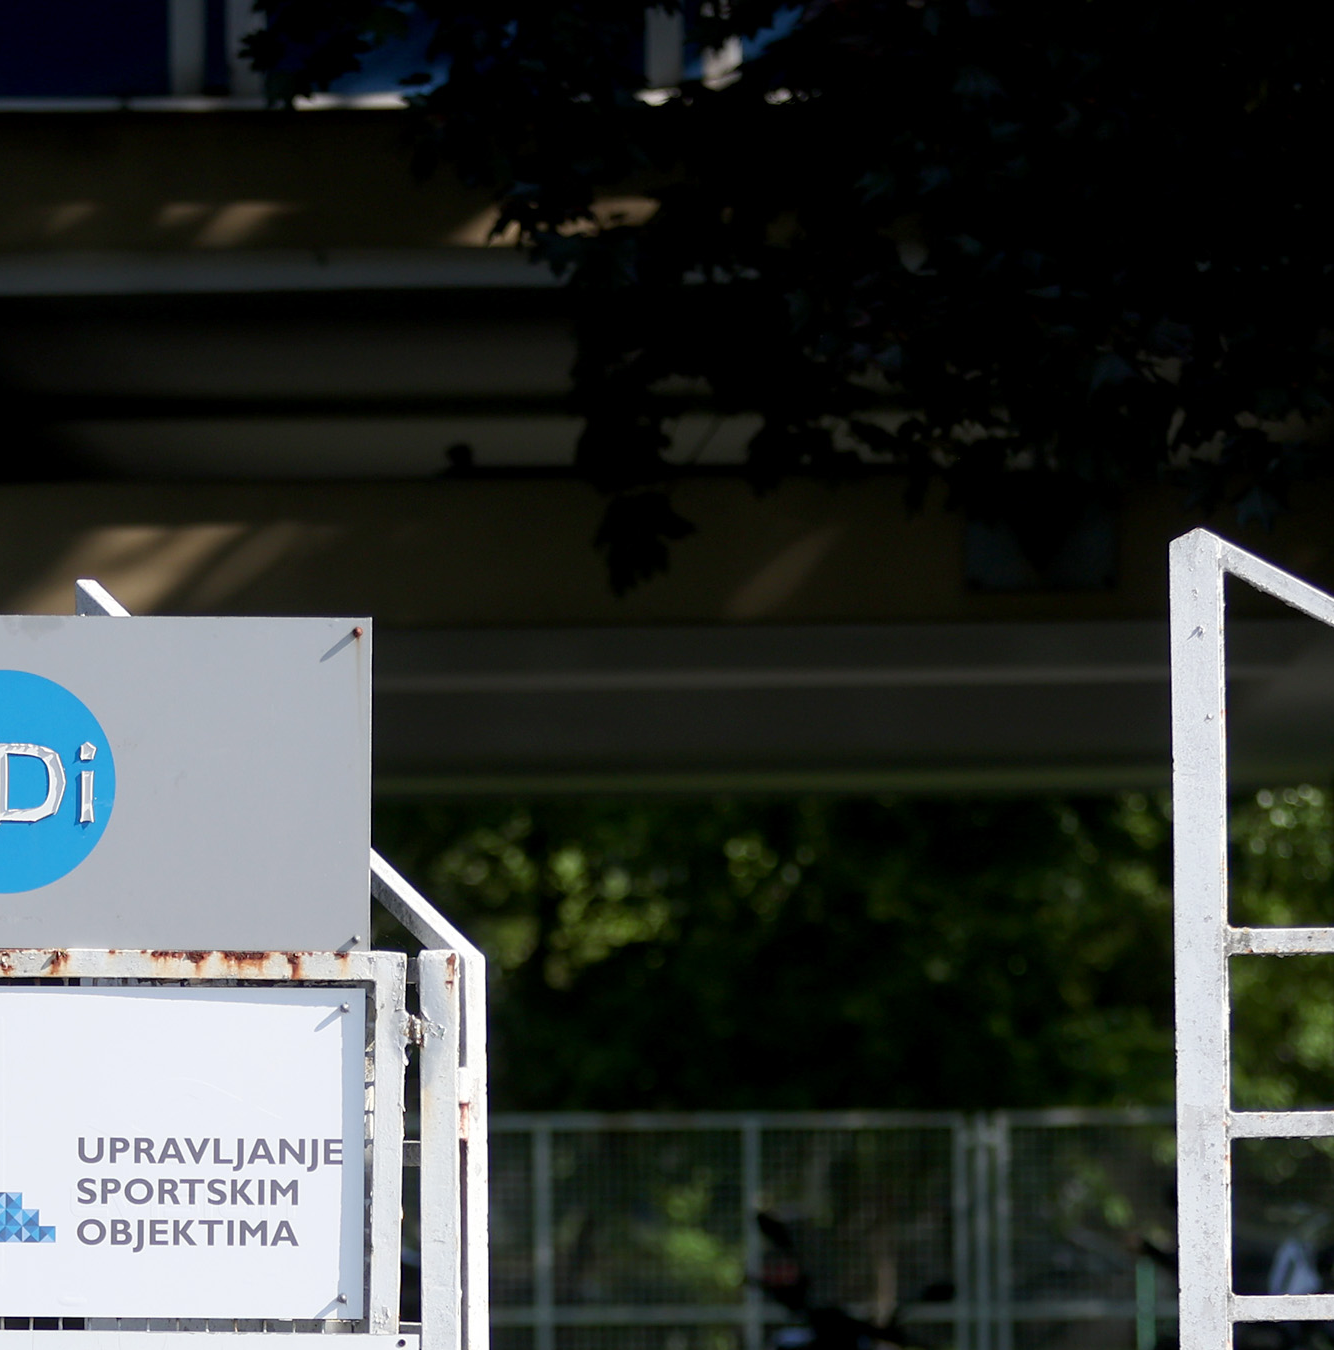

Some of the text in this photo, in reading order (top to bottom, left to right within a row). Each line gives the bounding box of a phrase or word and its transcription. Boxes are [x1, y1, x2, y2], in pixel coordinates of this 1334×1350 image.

[76, 1136, 344, 1172] UPRAVLJANJE
[76, 1177, 300, 1207] SPORTSKIM
[76, 1218, 300, 1252] OBJEKTIMA
